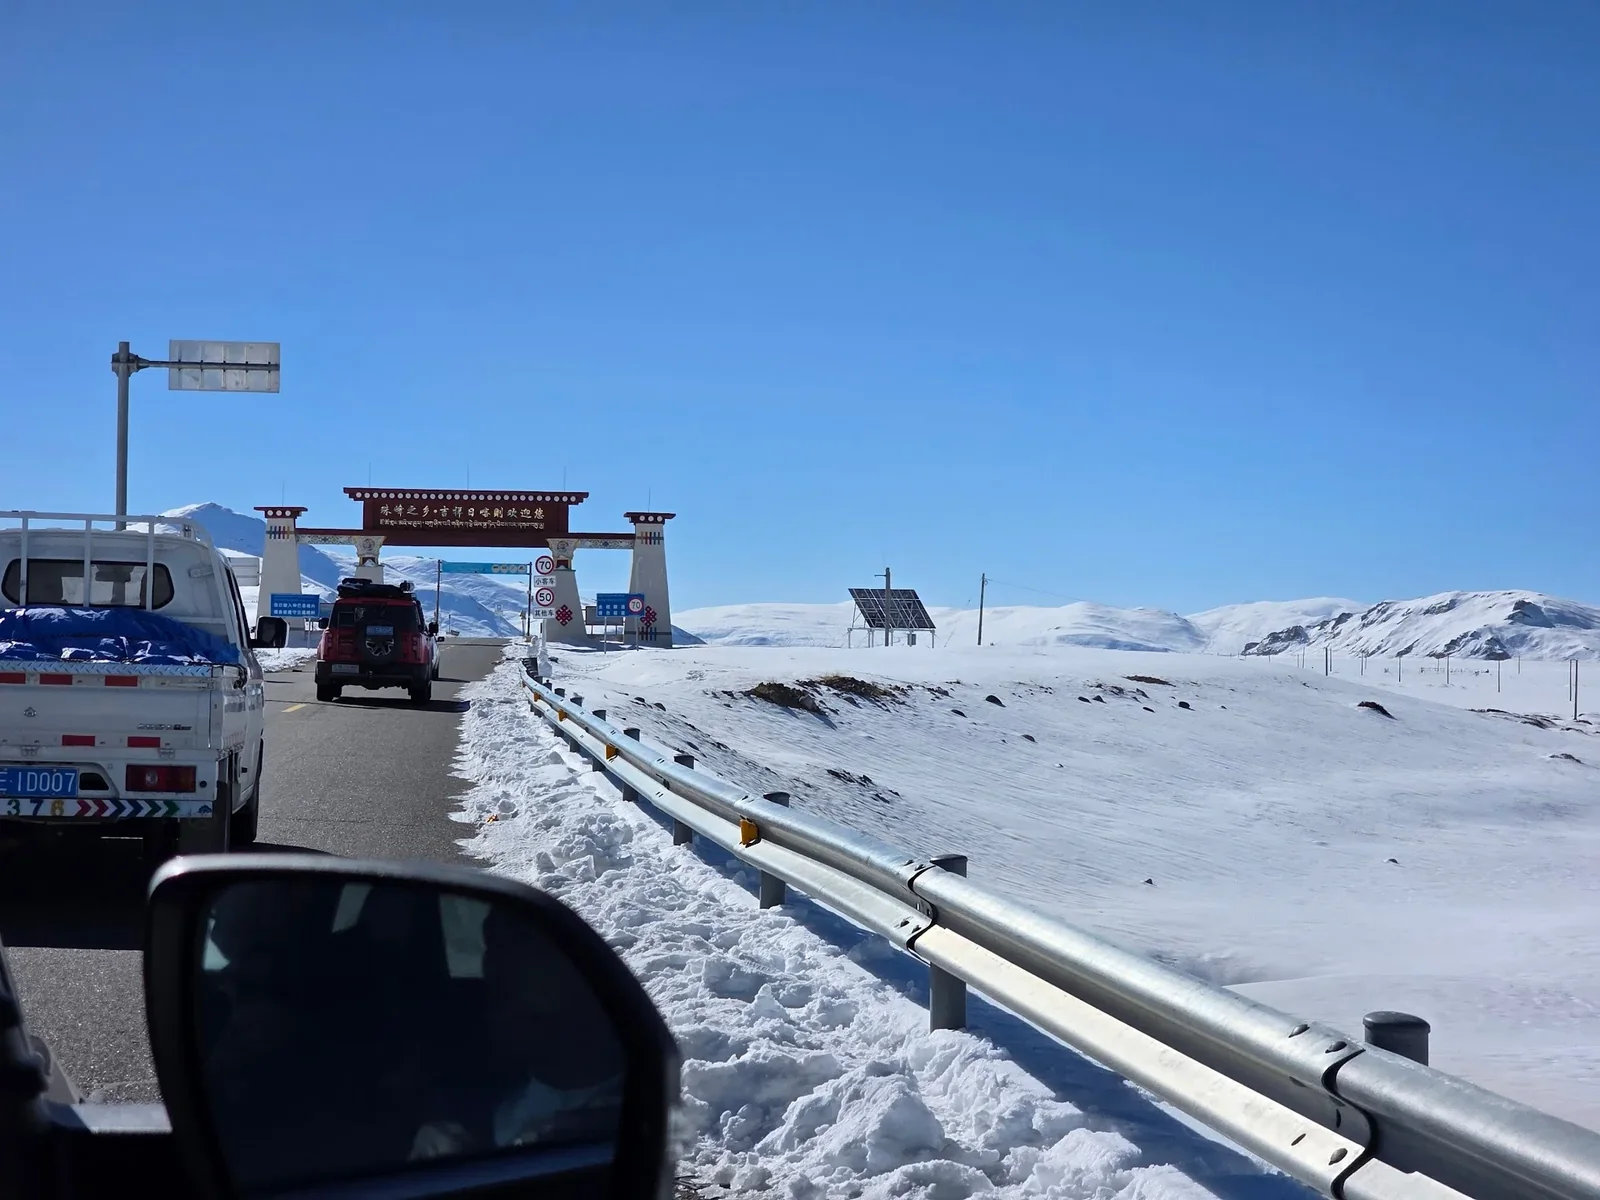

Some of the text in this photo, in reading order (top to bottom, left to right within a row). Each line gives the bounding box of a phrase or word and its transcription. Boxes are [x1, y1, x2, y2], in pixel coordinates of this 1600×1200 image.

[539, 561, 551, 570] 70
[535, 577, 555, 585] 小客车
[539, 593, 552, 602] 50
[631, 601, 640, 609] 70
[534, 609, 555, 617] 其他车
